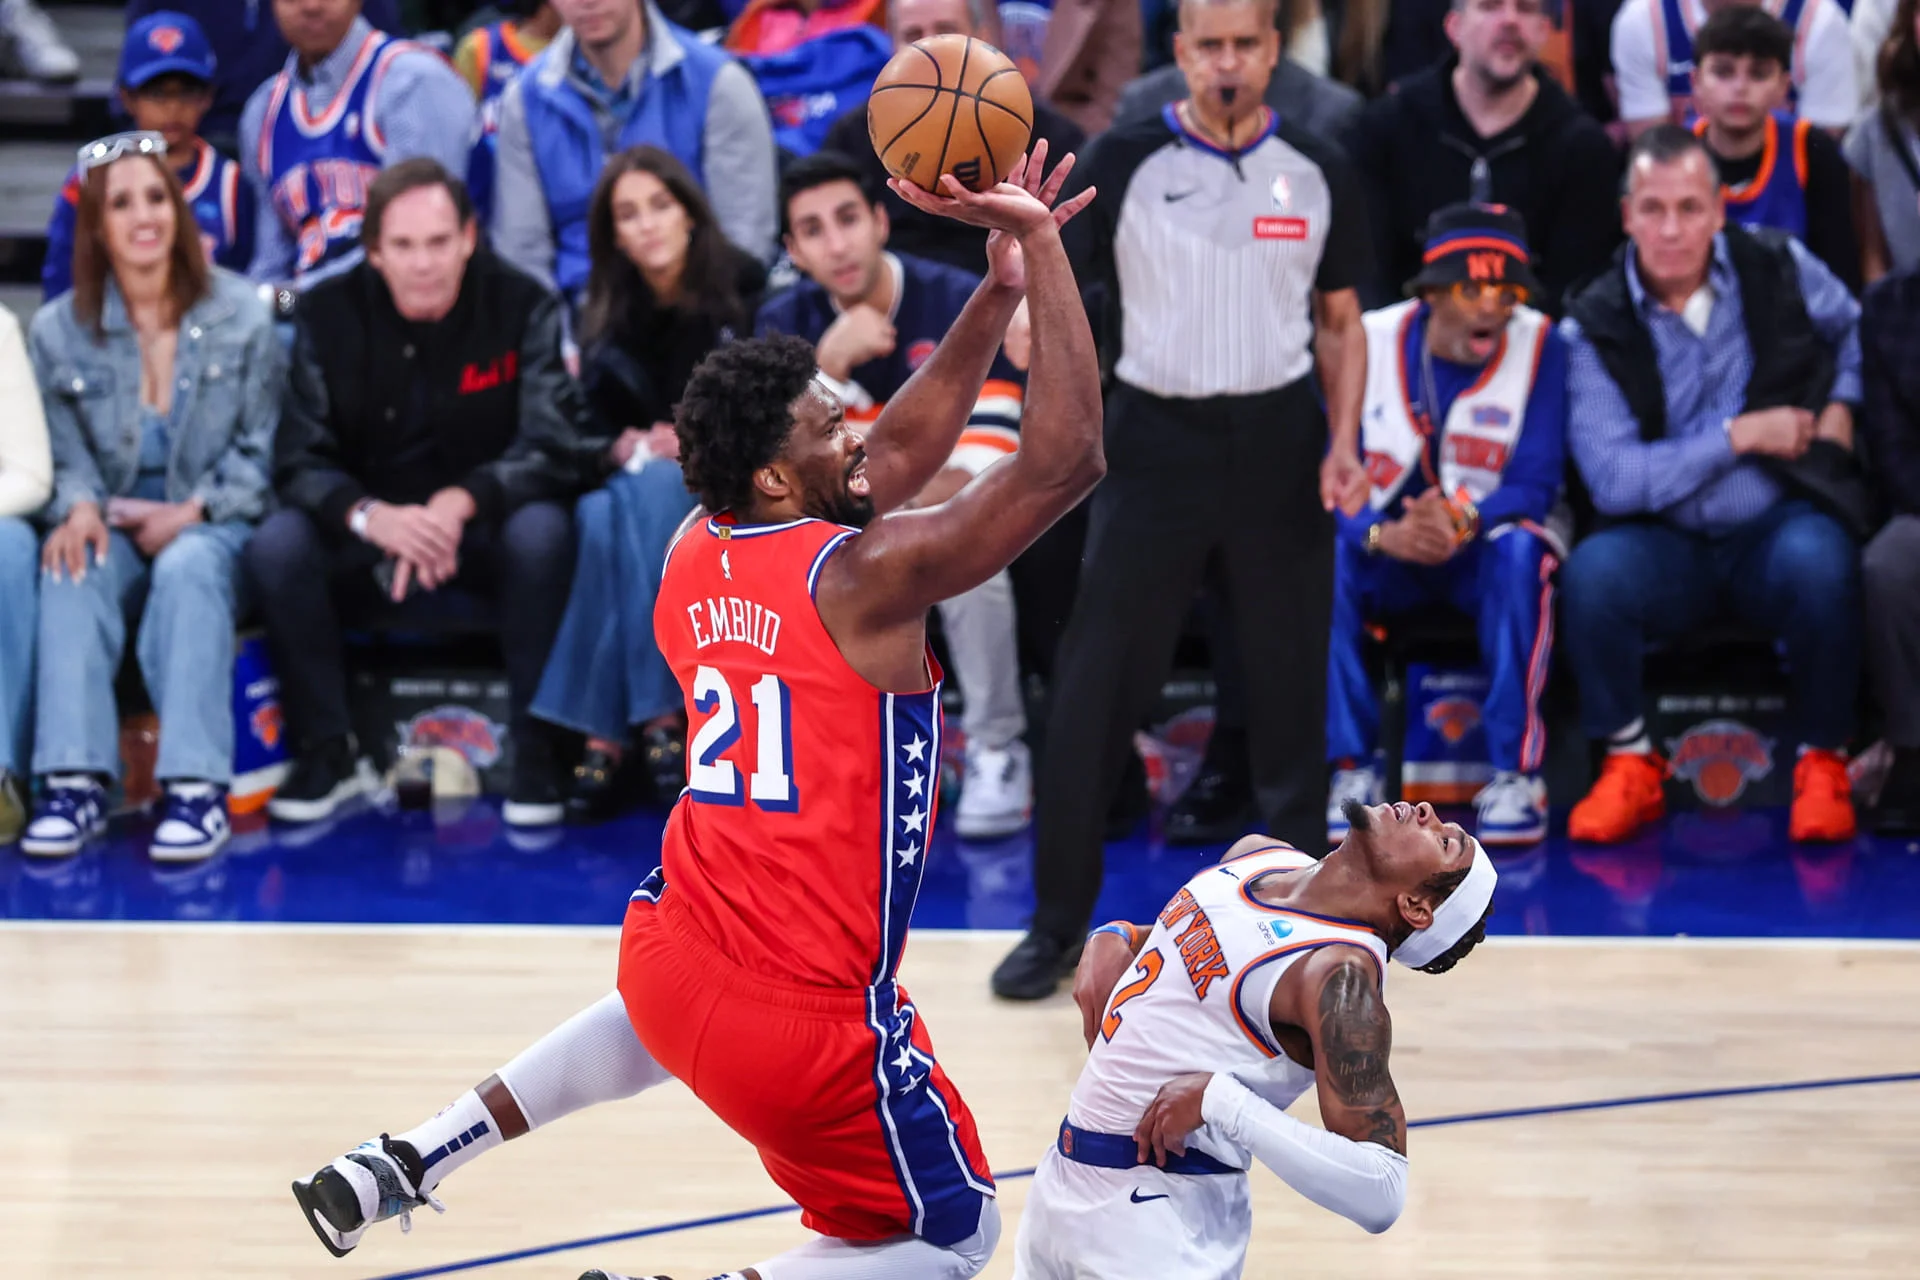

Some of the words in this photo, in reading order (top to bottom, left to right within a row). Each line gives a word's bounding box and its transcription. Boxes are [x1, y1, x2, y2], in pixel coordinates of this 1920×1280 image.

[1466, 252, 1505, 280] NY
[687, 596, 781, 656] EMBIID
[689, 664, 799, 814] 21
[1158, 887, 1200, 932] EW
[1174, 908, 1230, 1001] YORK
[1101, 947, 1165, 1044] 2
